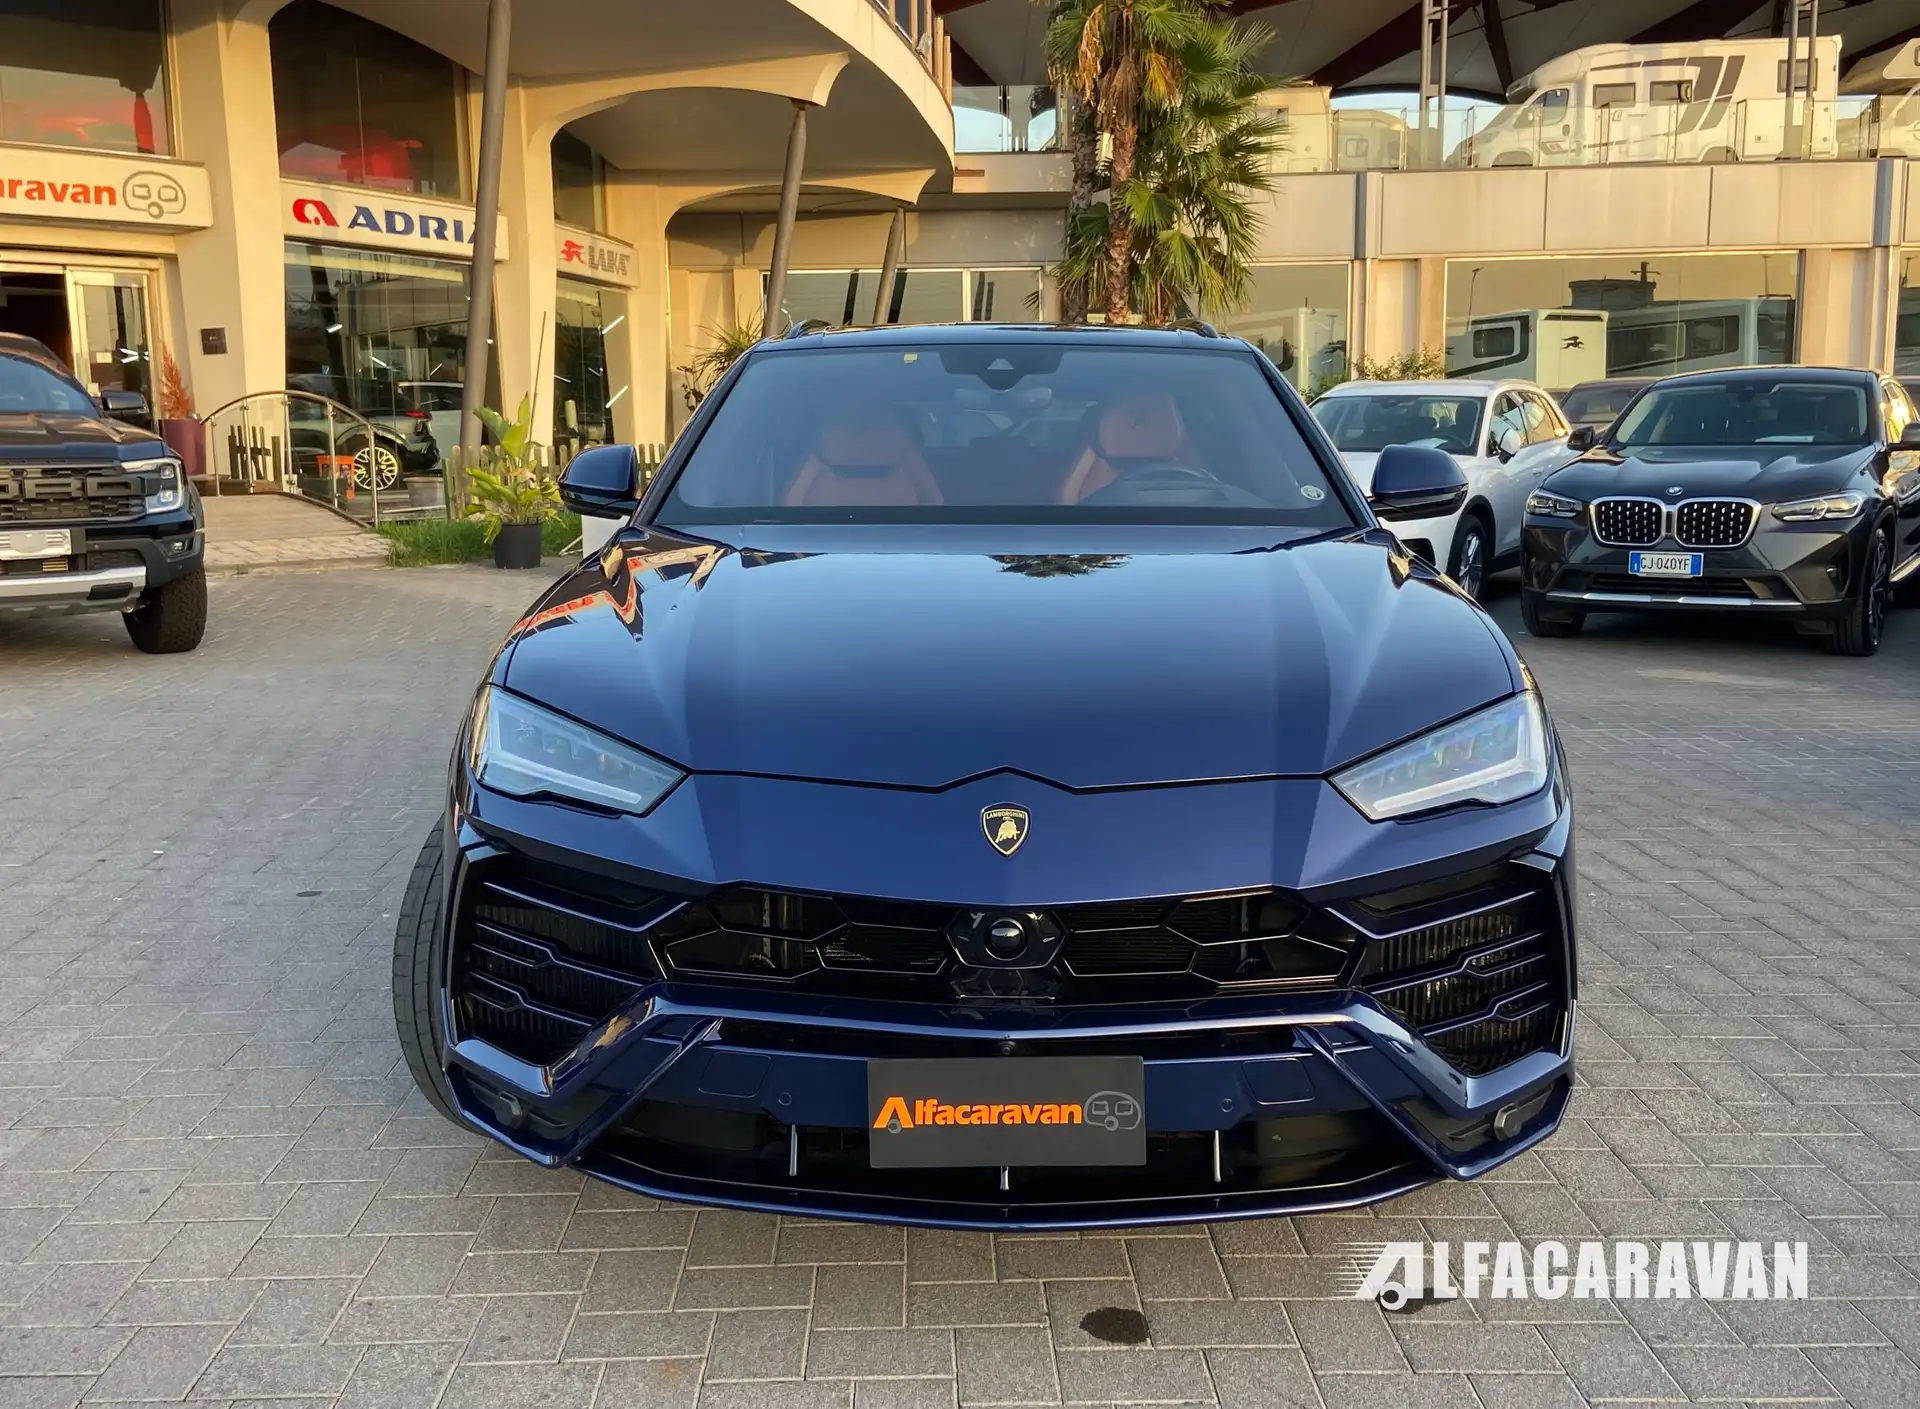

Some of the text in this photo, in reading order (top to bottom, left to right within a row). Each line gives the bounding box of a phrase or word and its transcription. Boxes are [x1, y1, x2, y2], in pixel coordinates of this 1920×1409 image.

[0, 178, 117, 206] ravan
[347, 205, 476, 243] ADRI
[873, 1096, 1082, 1129] Alfacaravan
